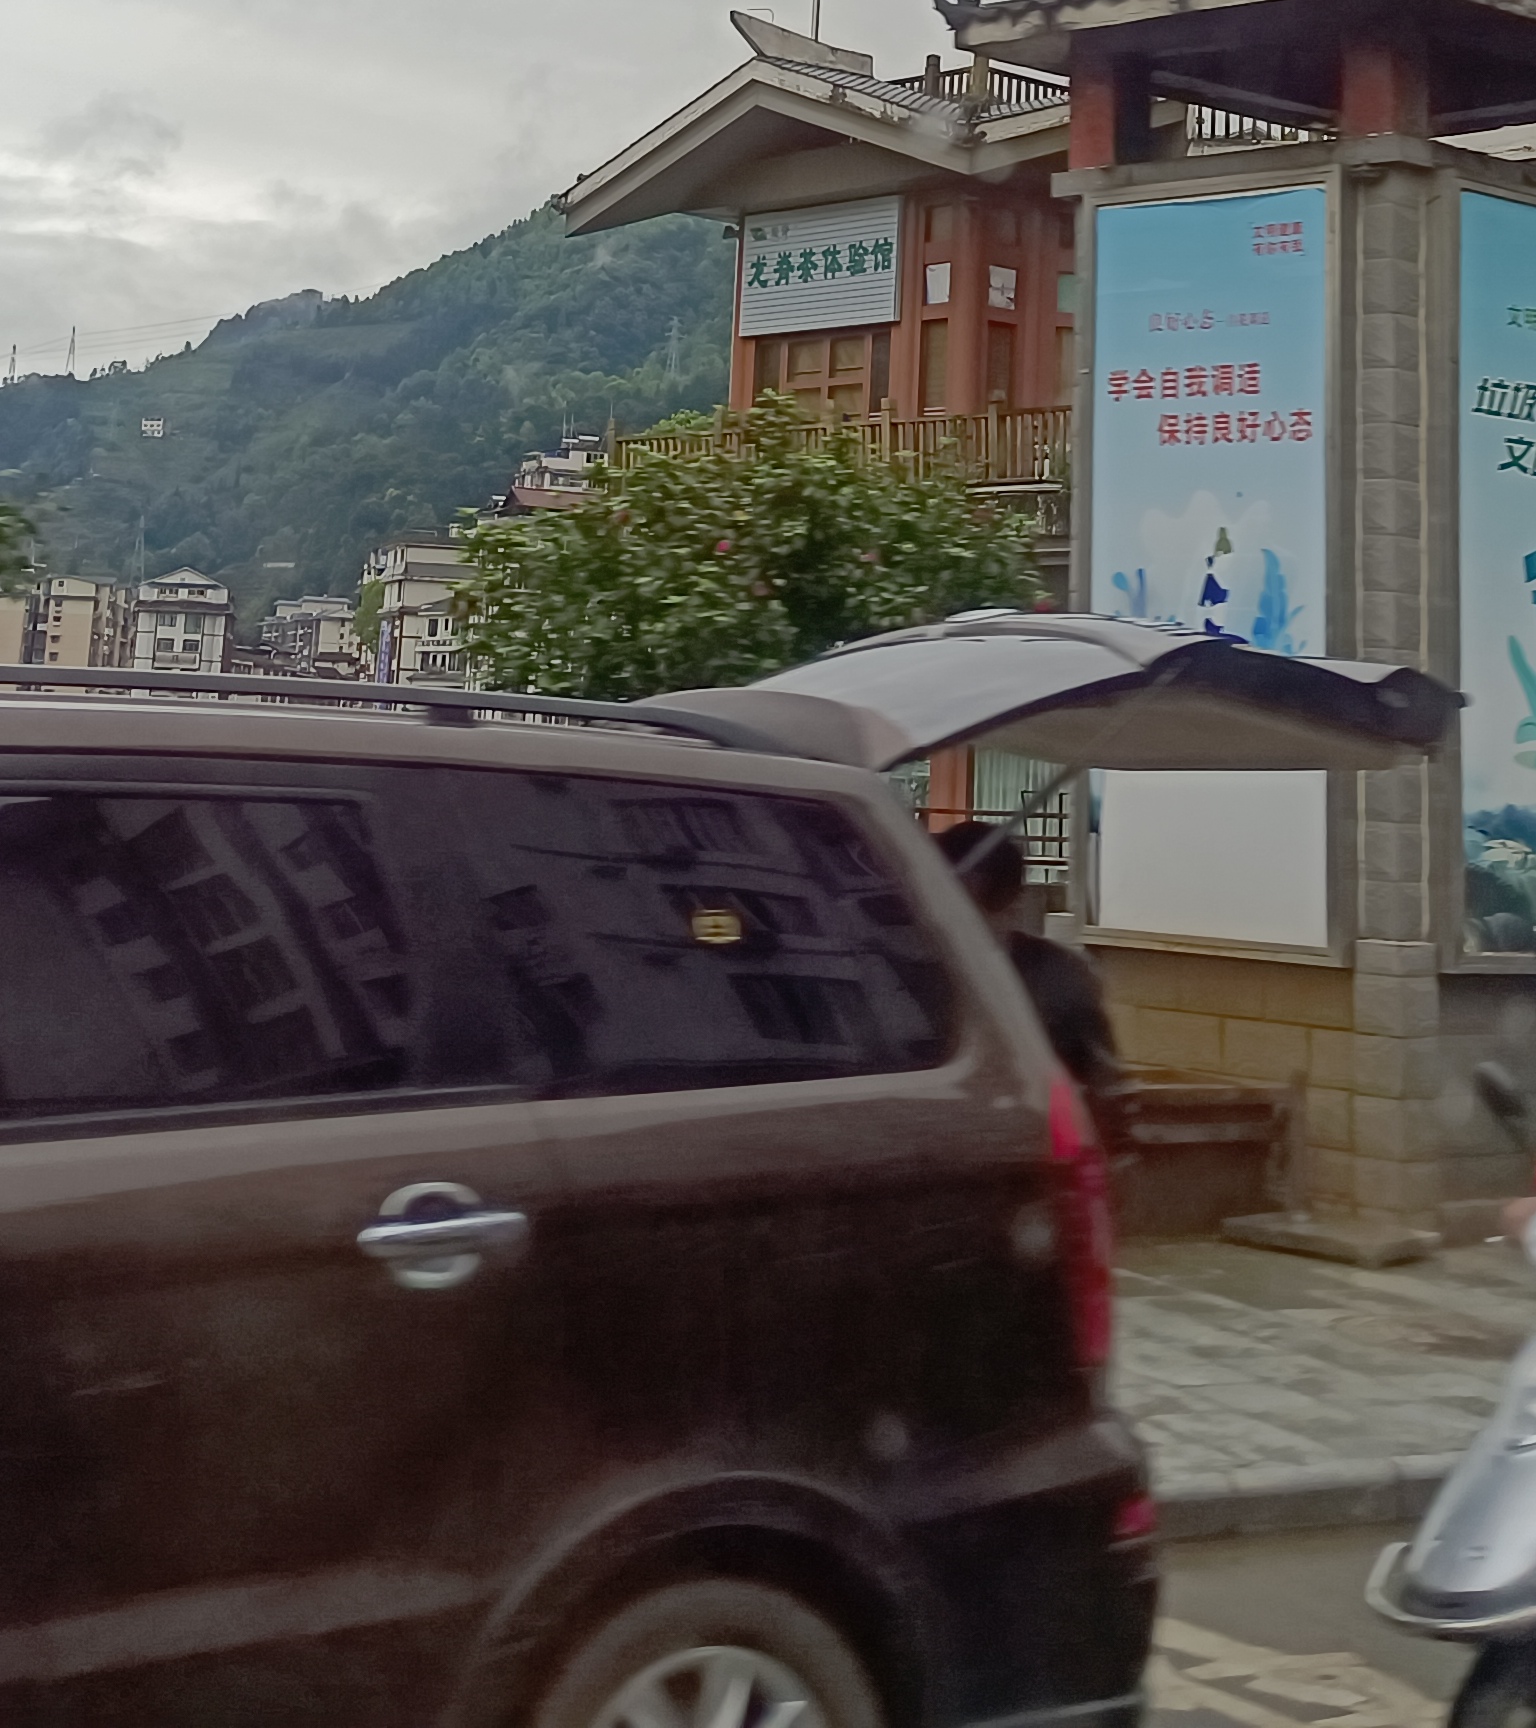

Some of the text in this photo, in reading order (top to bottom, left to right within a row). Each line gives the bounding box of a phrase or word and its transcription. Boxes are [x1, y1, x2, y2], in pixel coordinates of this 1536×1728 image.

[747, 237, 894, 288] 龙脊茶体验馆
[1107, 362, 1261, 402] 学会自我调适
[1157, 408, 1313, 446] 保持良好心态
